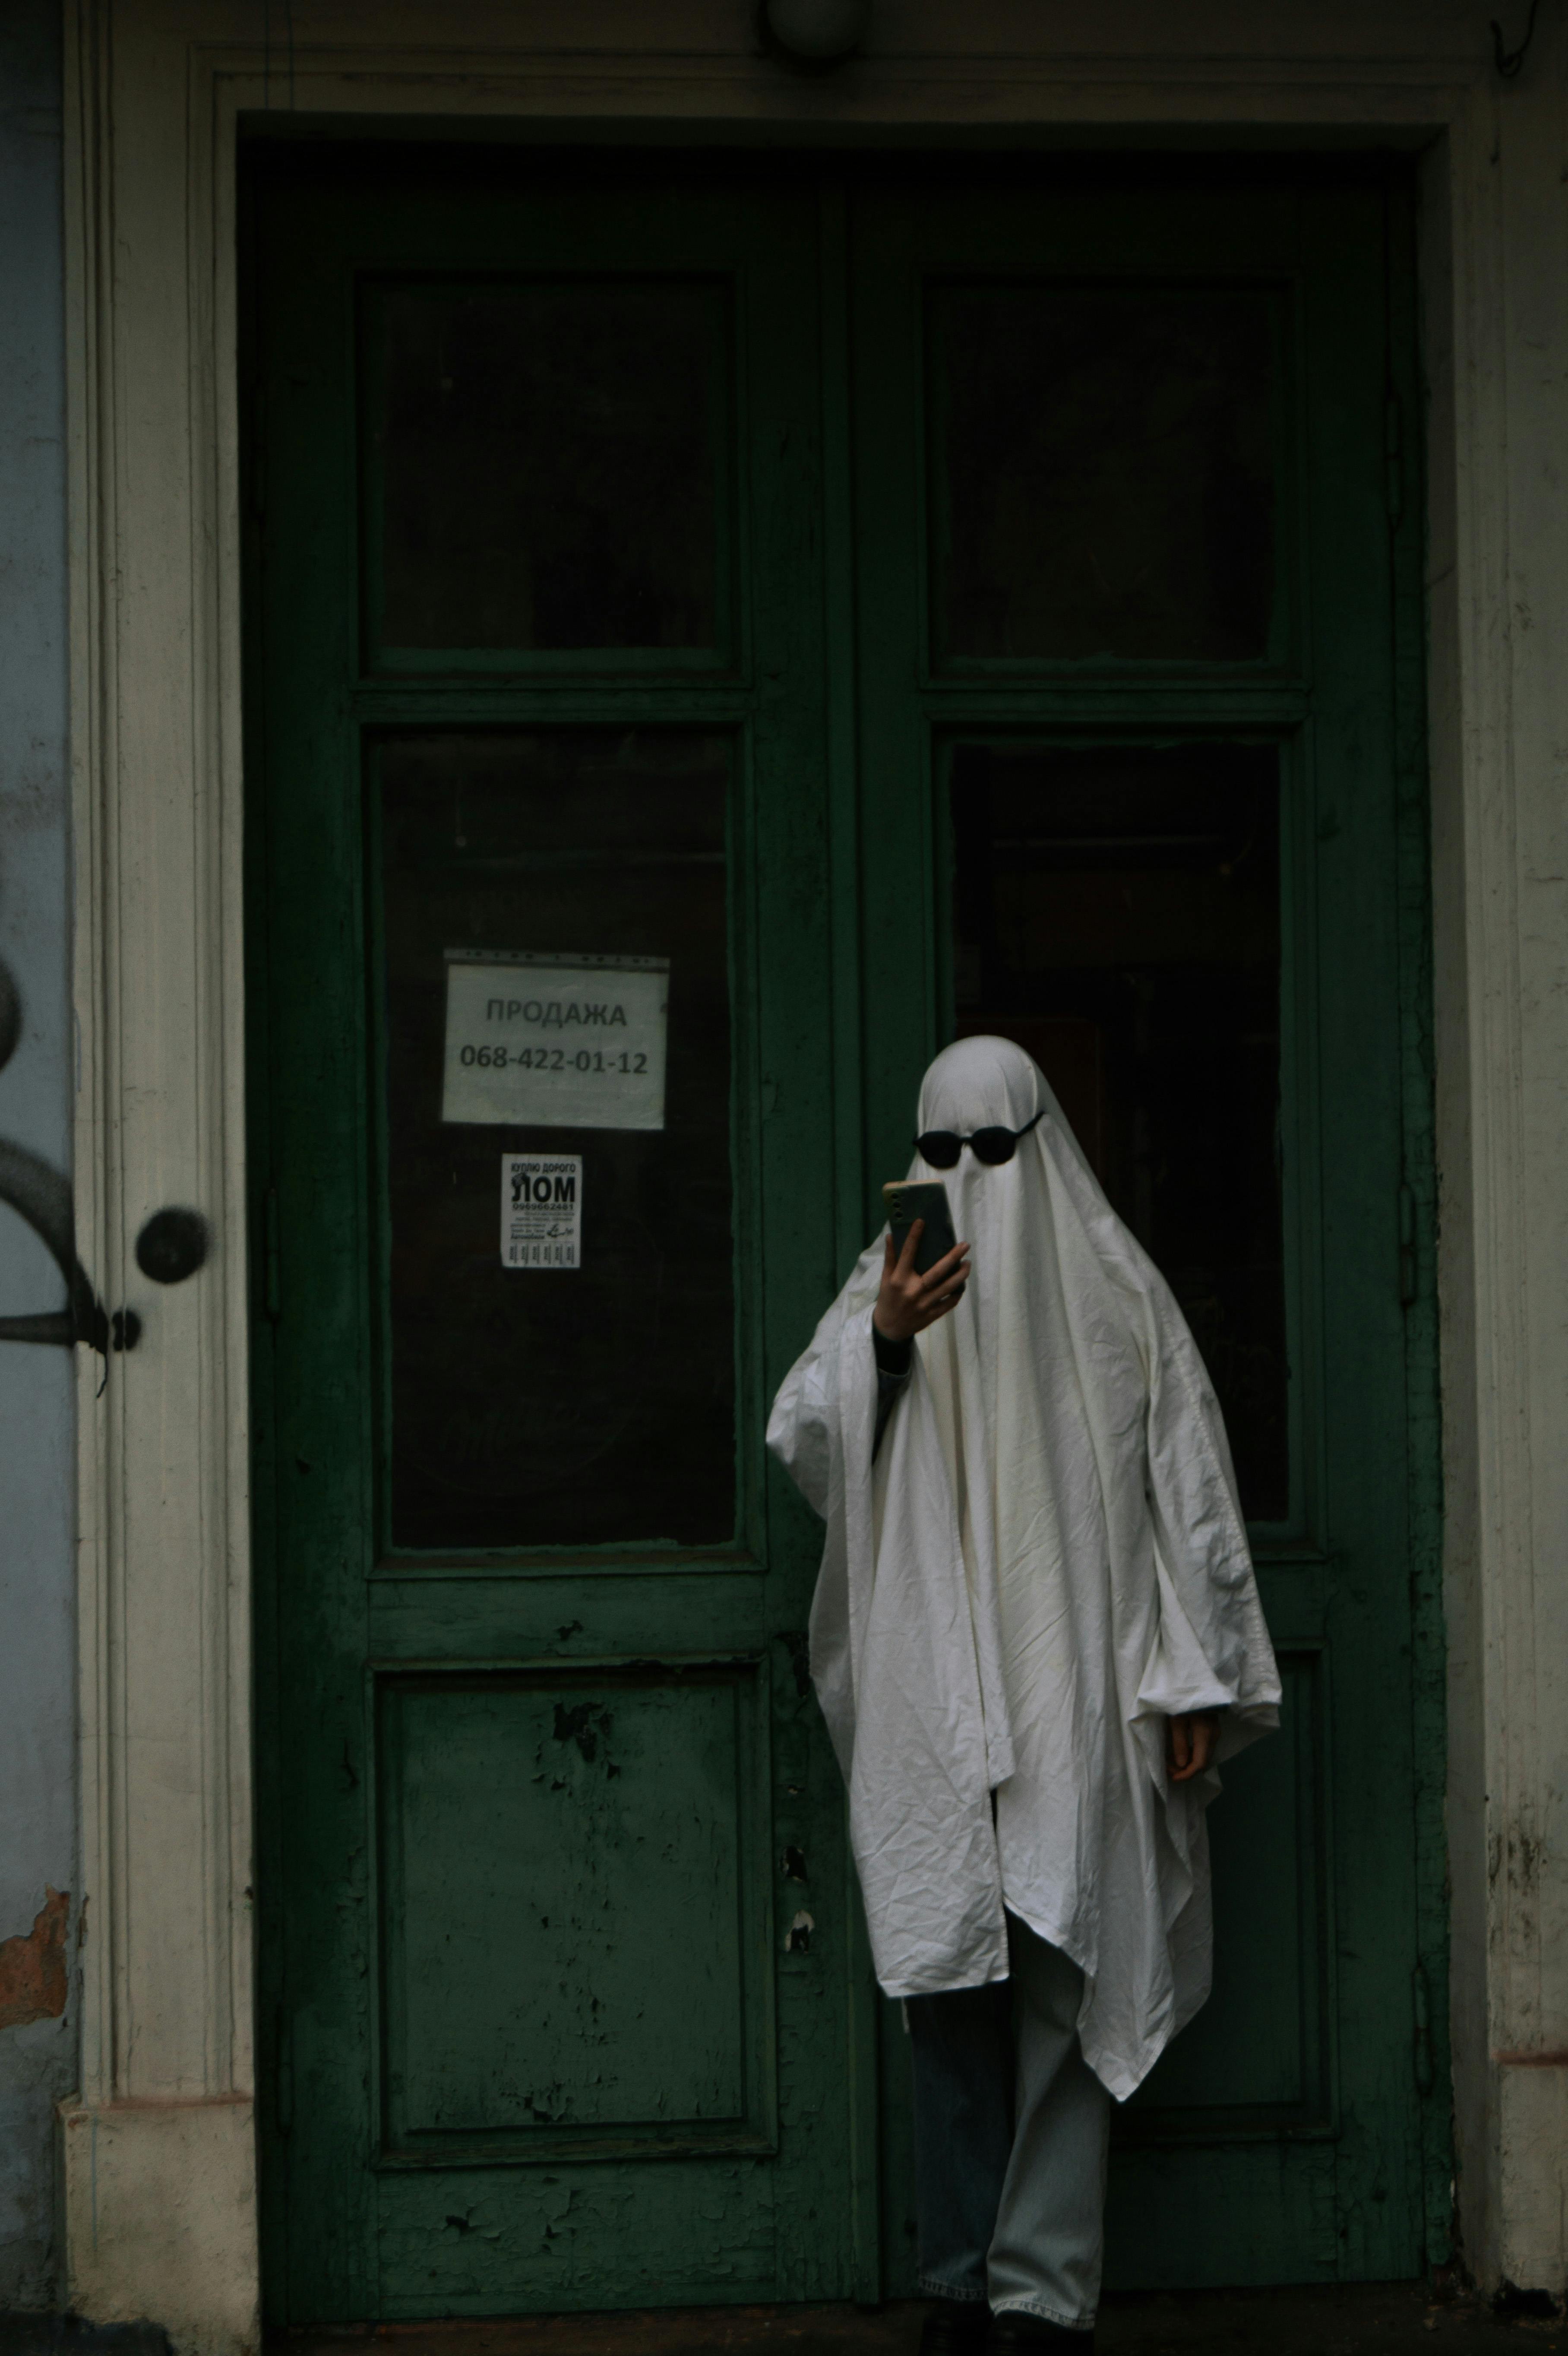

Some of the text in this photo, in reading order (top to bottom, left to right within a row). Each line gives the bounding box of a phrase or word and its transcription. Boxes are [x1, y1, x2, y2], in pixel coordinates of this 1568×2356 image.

[487, 999, 627, 1028] ПРОДАЖА
[460, 1045, 648, 1074] 068-422-01-12
[511, 1162, 575, 1173] КУПЛЮ ДОРОГО
[512, 1175, 575, 1202] ЛОМ
